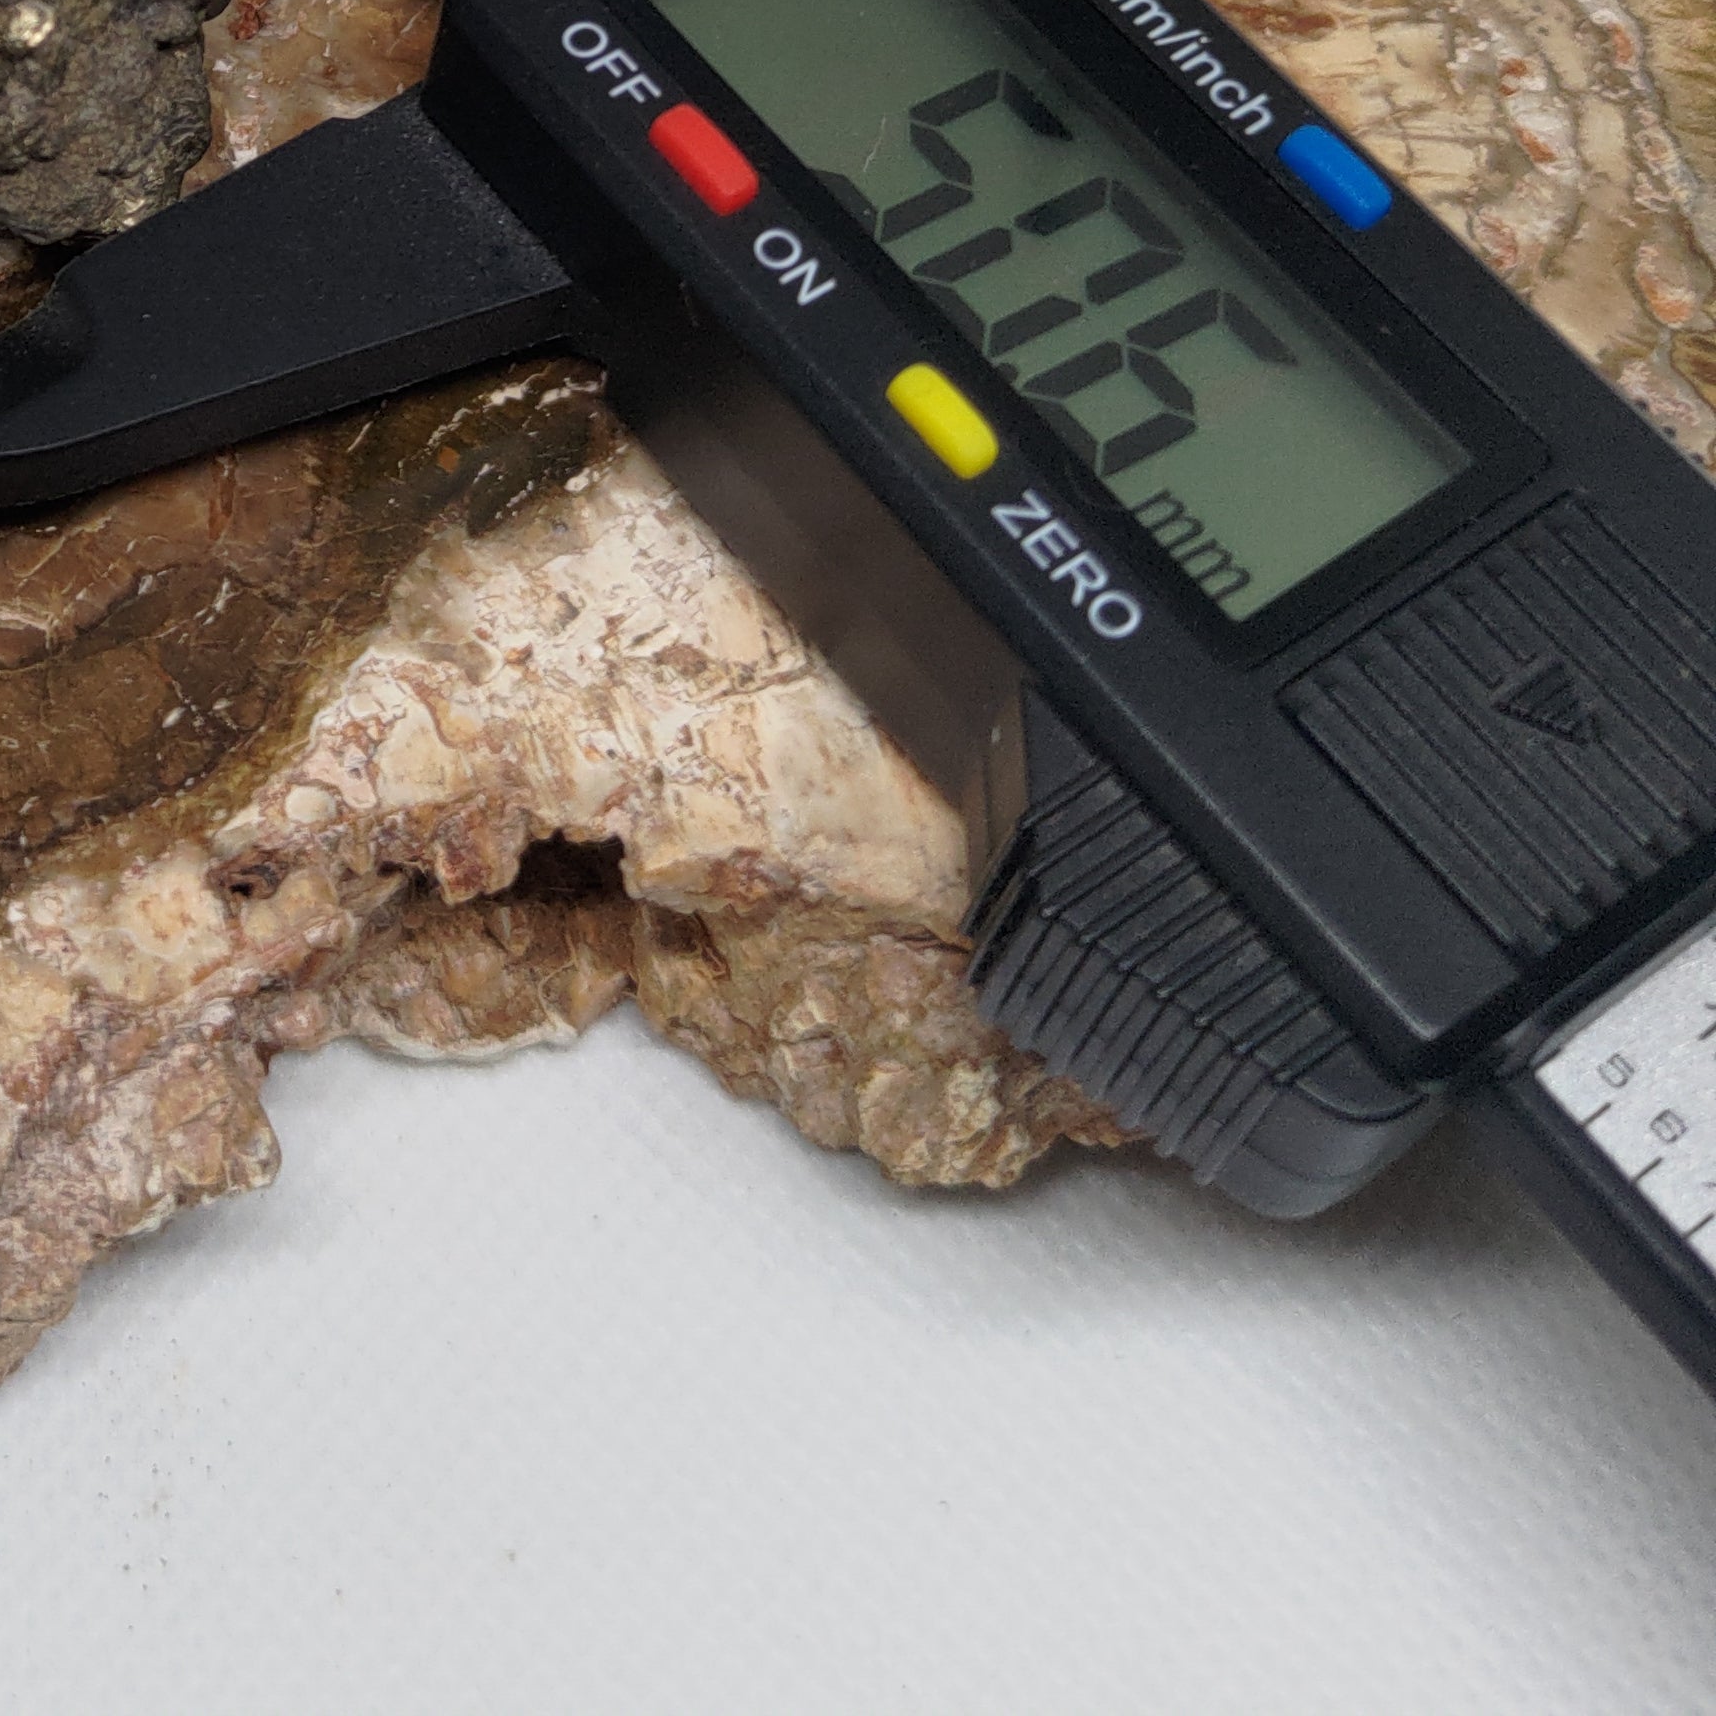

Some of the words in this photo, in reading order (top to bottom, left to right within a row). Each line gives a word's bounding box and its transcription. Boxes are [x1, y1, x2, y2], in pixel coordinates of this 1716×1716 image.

[561, 21, 663, 104] OFF
[753, 228, 837, 306] ON
[989, 488, 1144, 640] ZERO
[1597, 1053, 1635, 1088] 5
